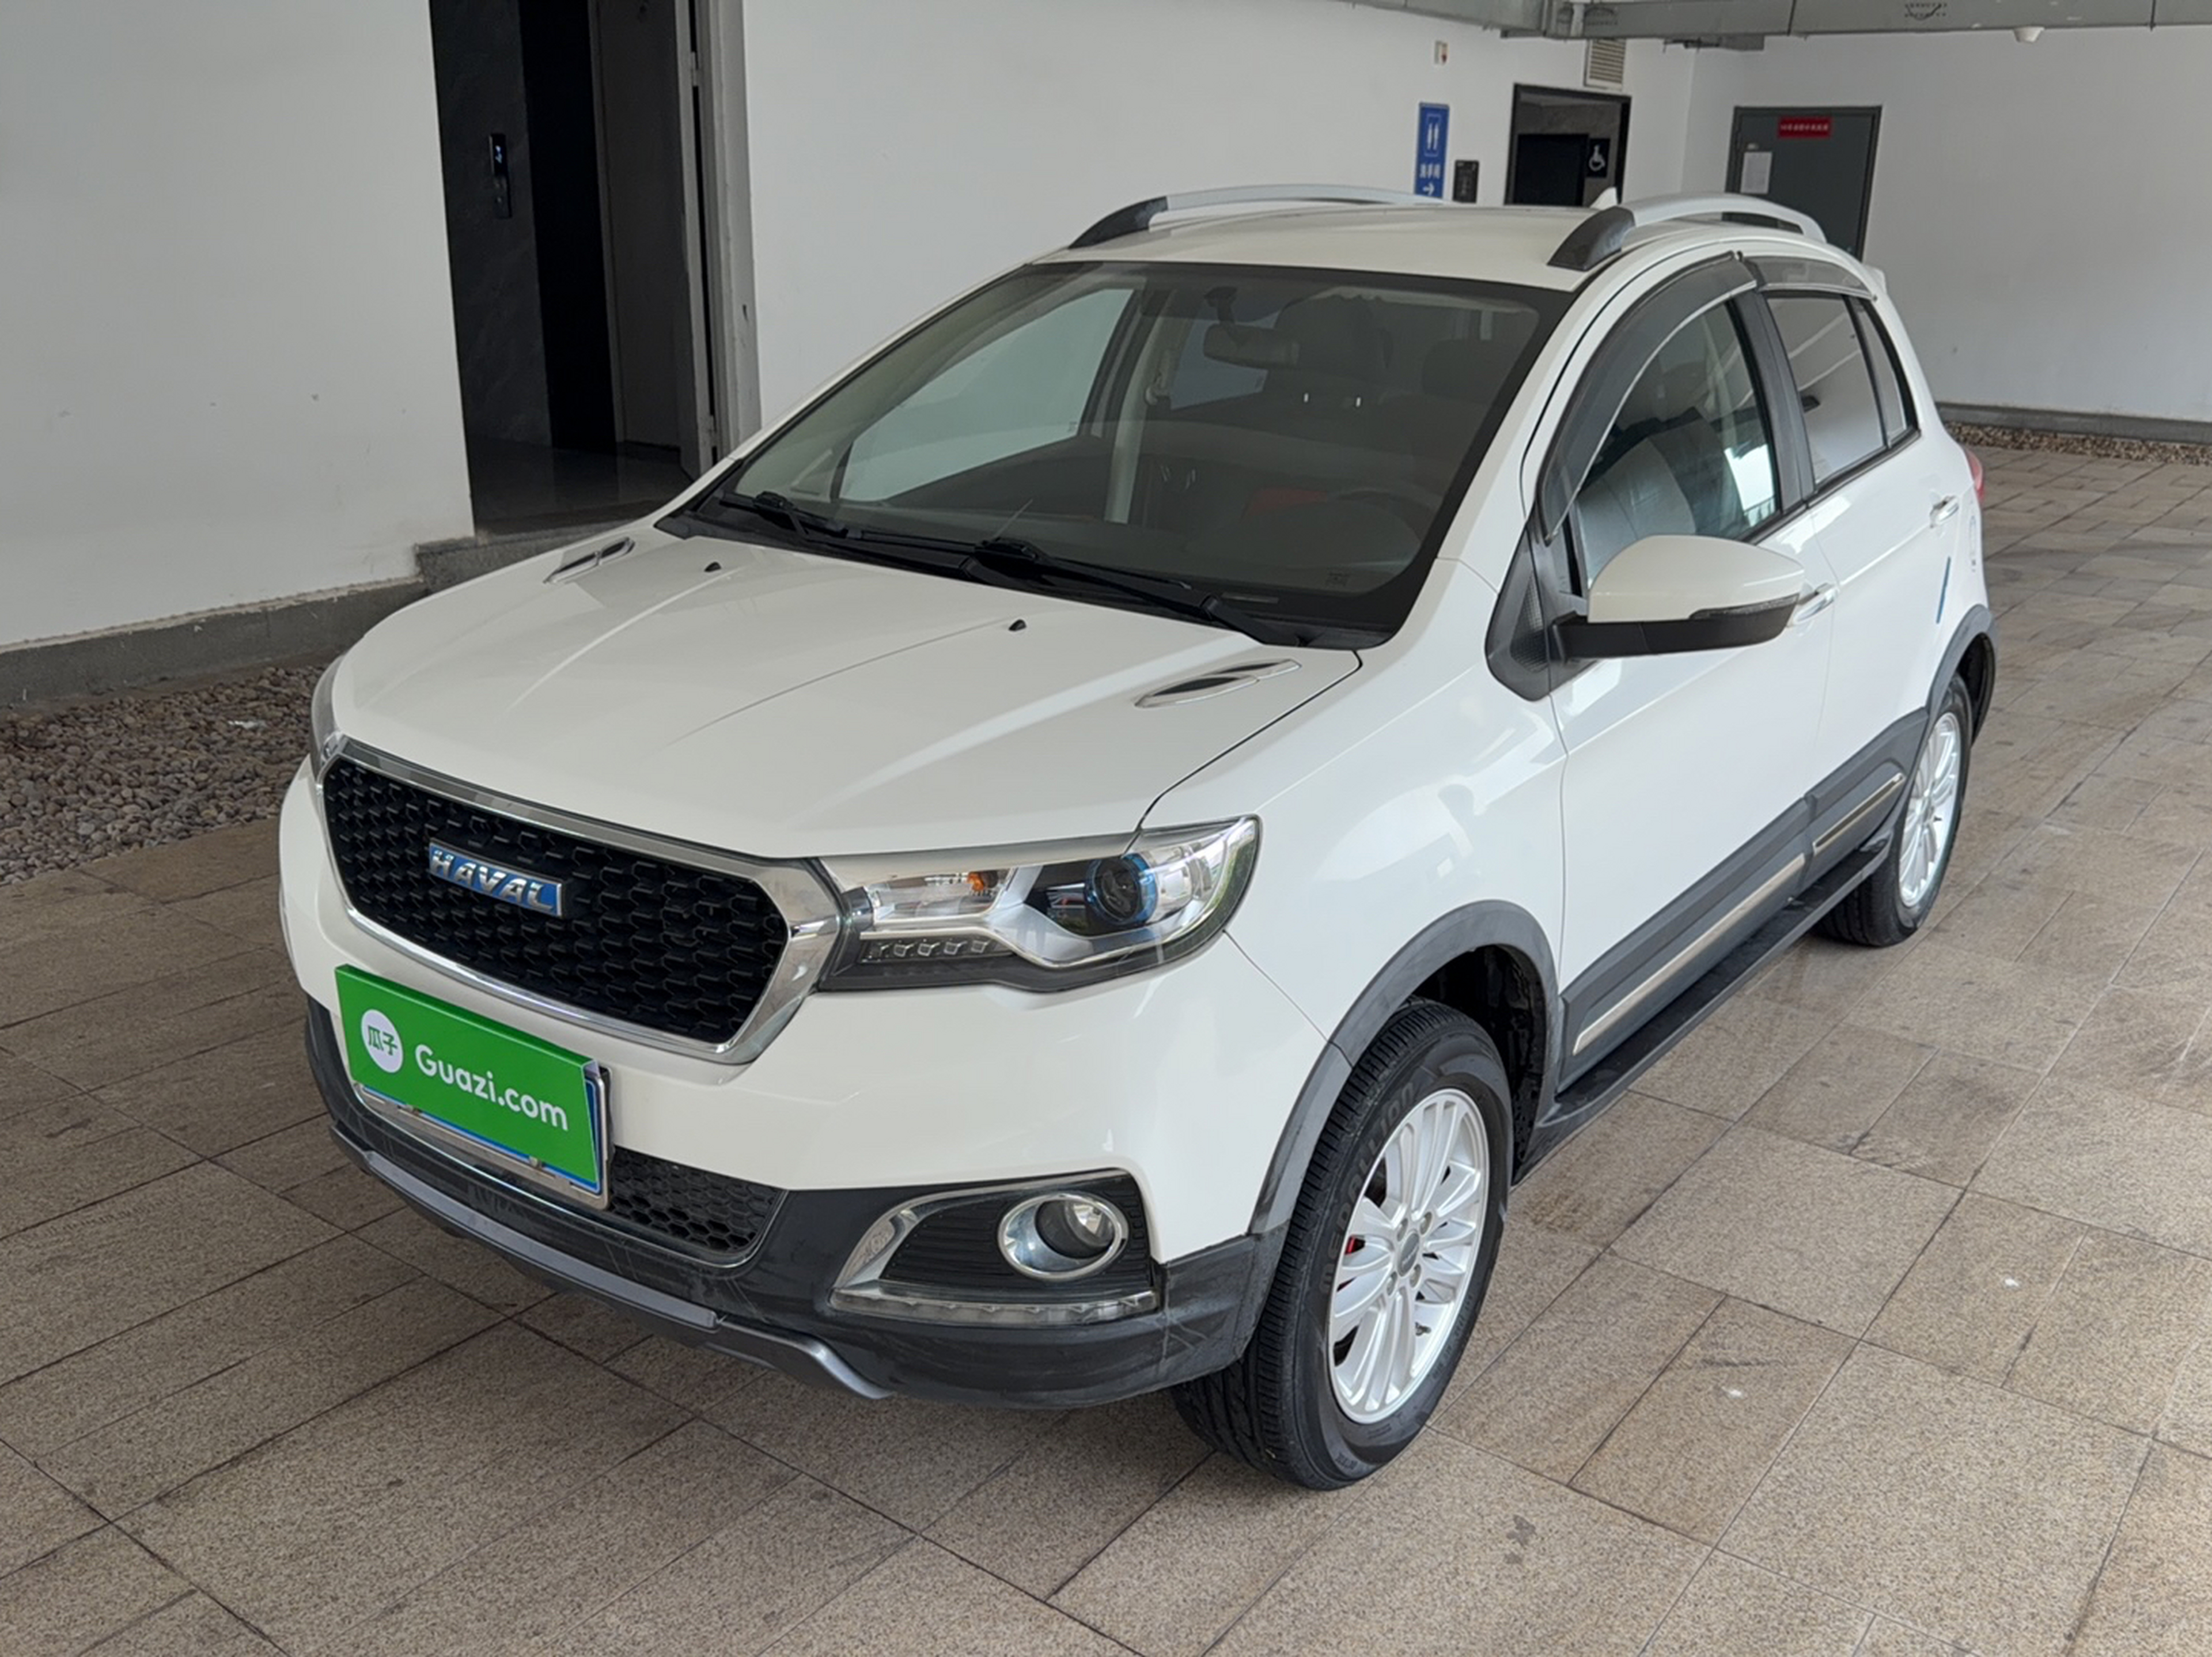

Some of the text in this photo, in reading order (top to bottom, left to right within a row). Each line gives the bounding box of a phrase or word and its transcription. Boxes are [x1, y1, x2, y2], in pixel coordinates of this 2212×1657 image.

[430, 850, 553, 911] HAVAL
[367, 1025, 398, 1056] 瓜子
[415, 1044, 569, 1132] Guazi.com
